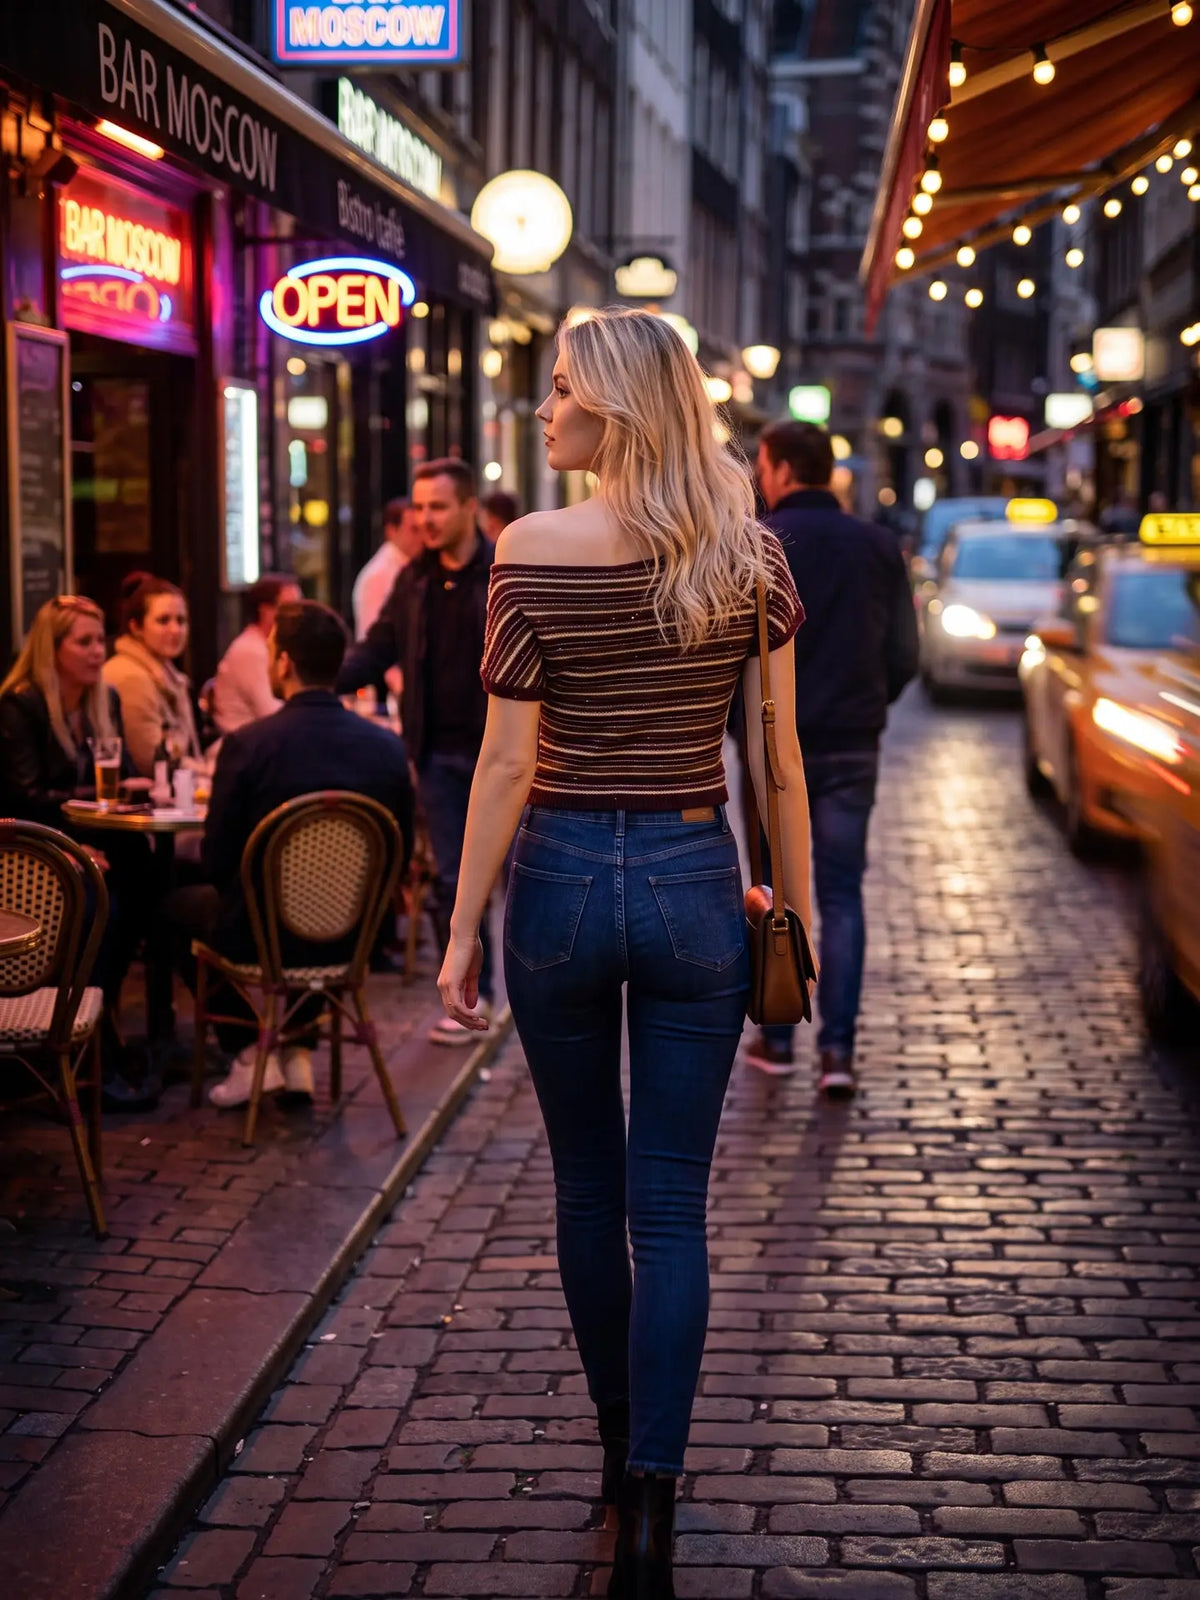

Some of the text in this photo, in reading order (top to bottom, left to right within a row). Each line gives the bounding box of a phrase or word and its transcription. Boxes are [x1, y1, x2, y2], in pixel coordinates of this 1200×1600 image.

[289, 5, 446, 47] MOSCOW
[99, 22, 278, 192] BAR MOSCOW
[65, 200, 106, 261] BAR
[273, 274, 400, 327] OPEN
